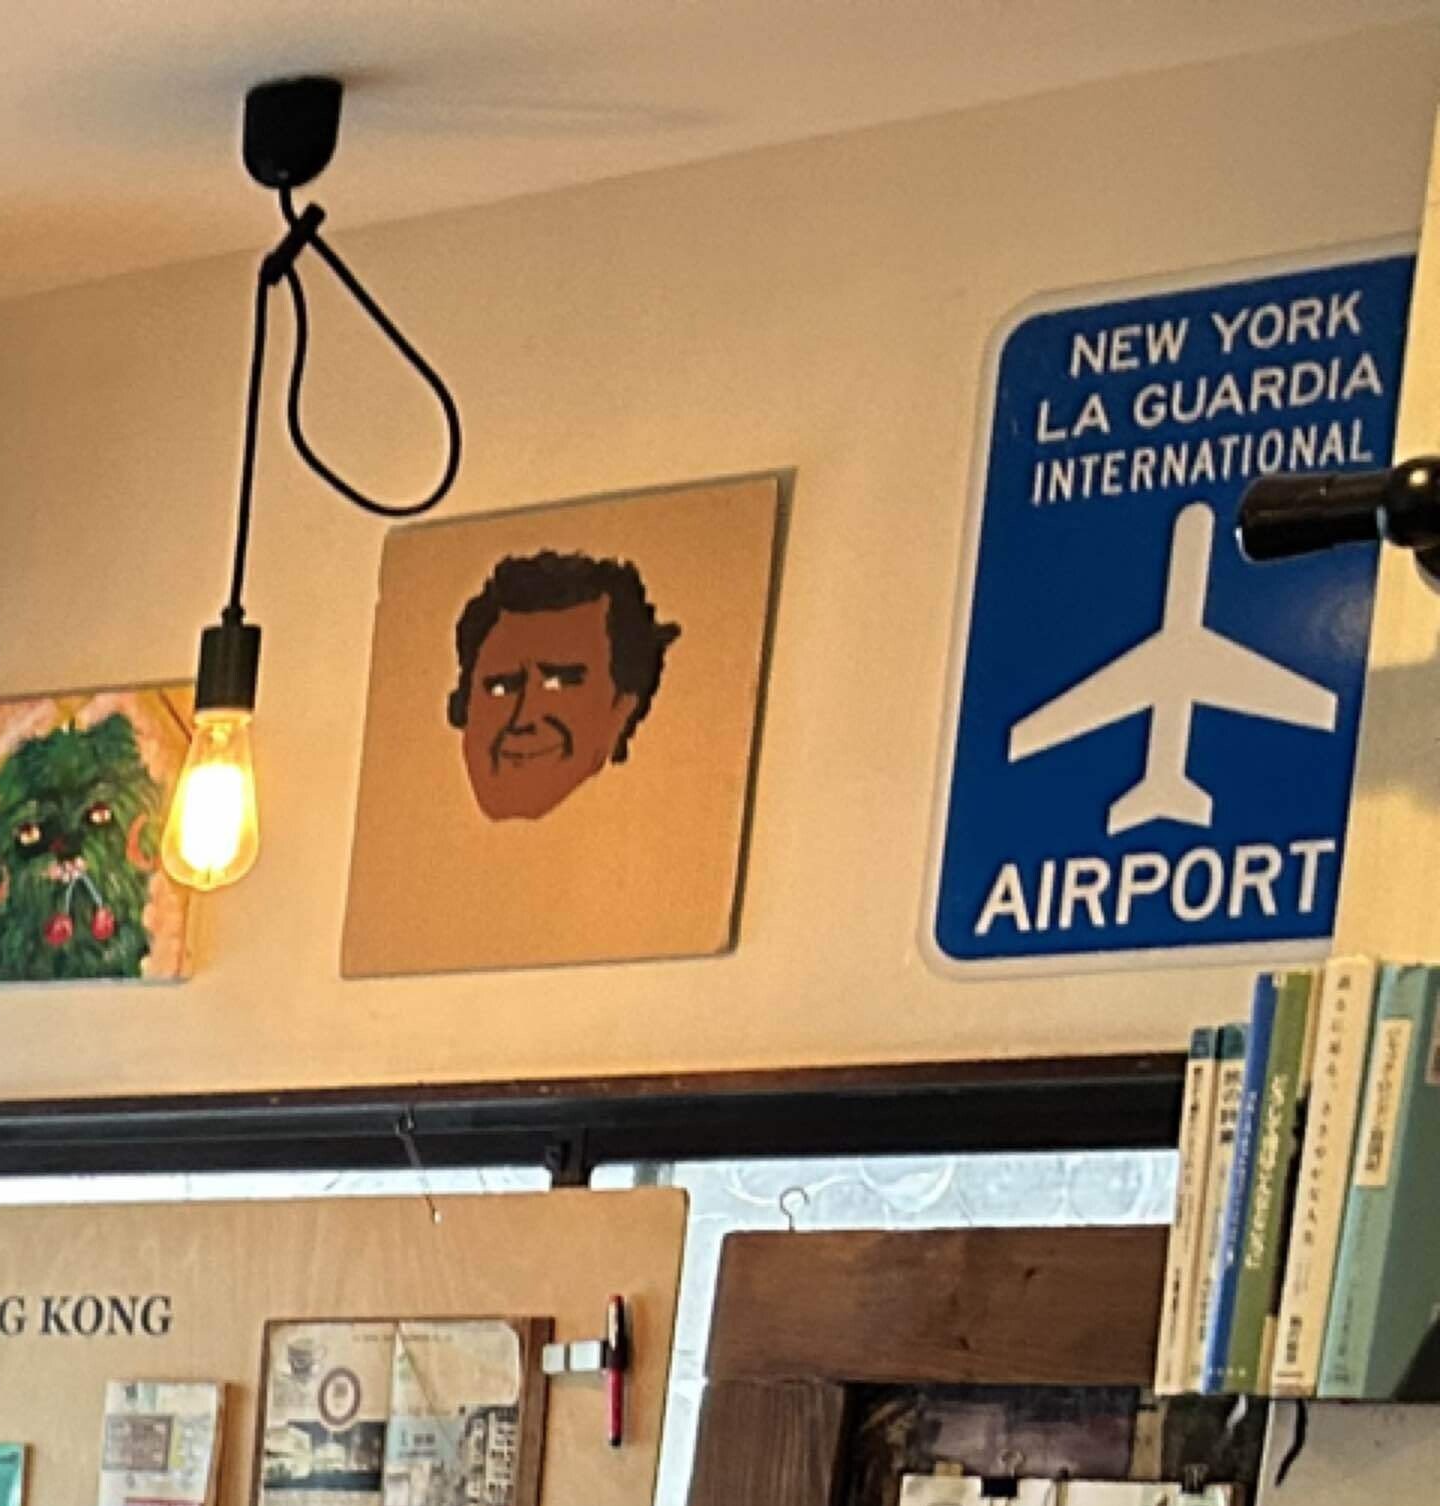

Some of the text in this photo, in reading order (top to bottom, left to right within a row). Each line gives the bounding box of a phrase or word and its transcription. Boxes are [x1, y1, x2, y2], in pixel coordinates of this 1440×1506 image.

[1069, 290, 1363, 378] NEW YORK
[1036, 353, 1383, 443] LA GUARDIA
[1031, 418, 1373, 507] INTERNATIONAL
[975, 838, 1337, 937] AIRPORT
[40, 1294, 174, 1339] KONG
